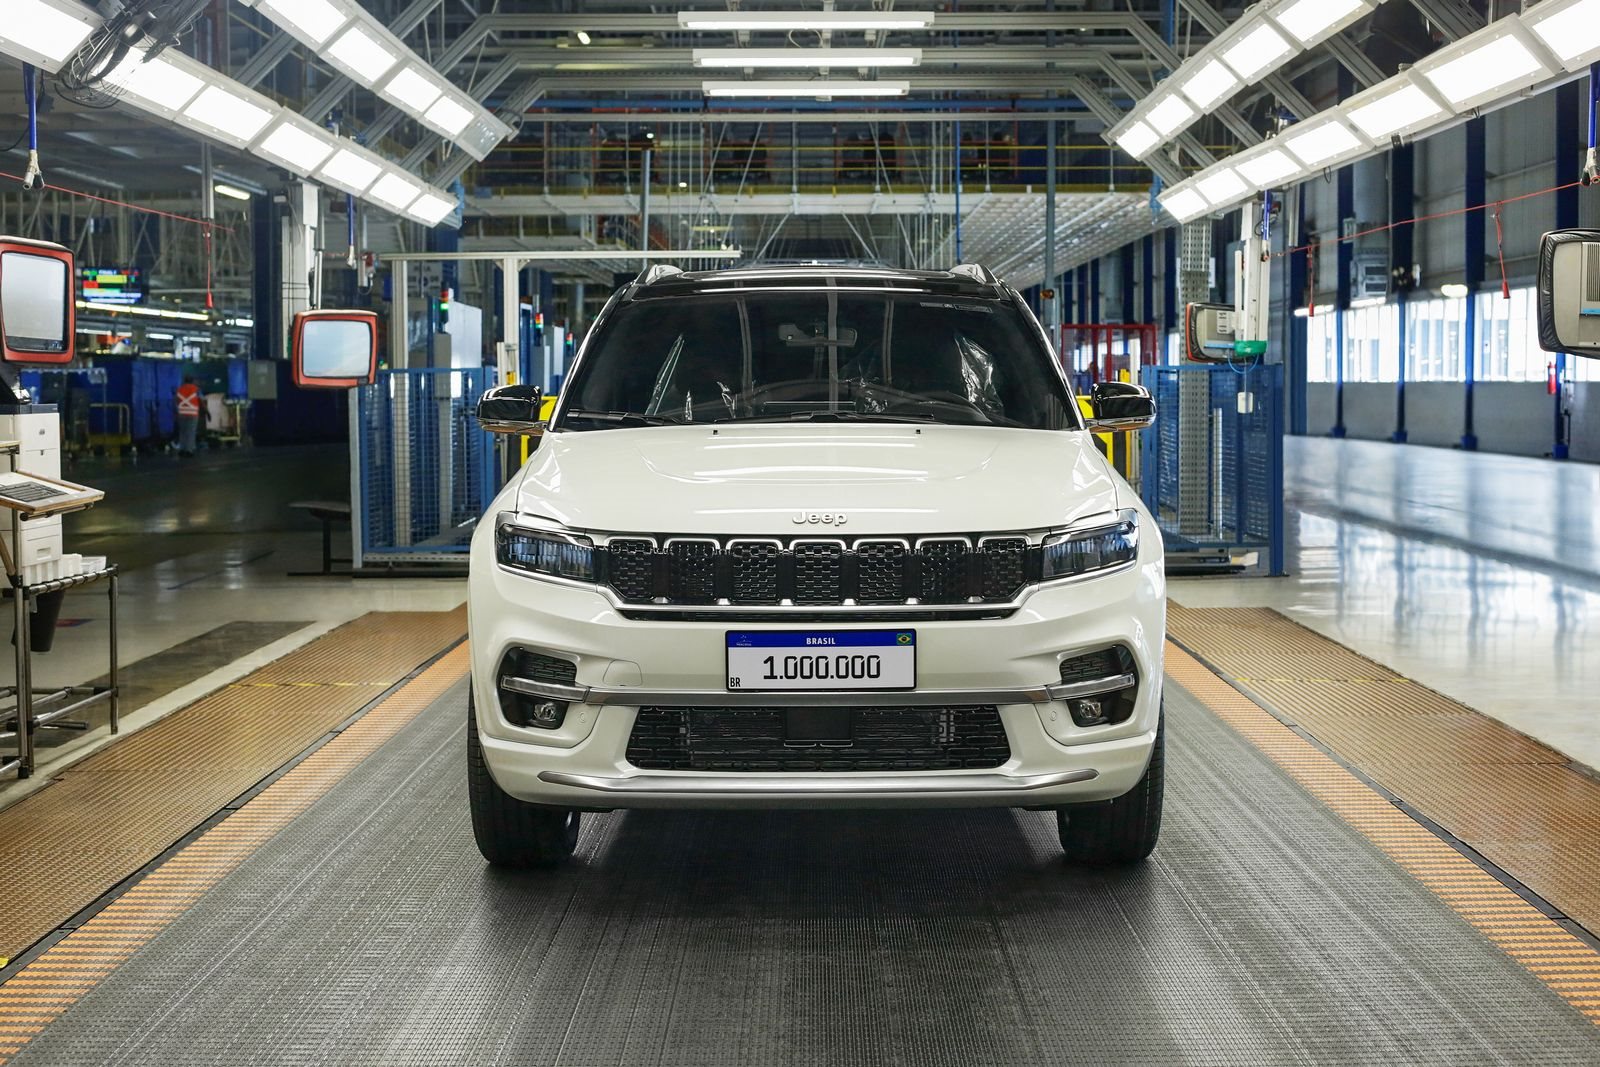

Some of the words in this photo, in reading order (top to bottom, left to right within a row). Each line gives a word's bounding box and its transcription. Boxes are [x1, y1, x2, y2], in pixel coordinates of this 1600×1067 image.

[792, 511, 848, 527] Jeep
[806, 637, 836, 645] BRASIL
[763, 655, 881, 680] 1.000.000
[730, 677, 741, 688] BR
